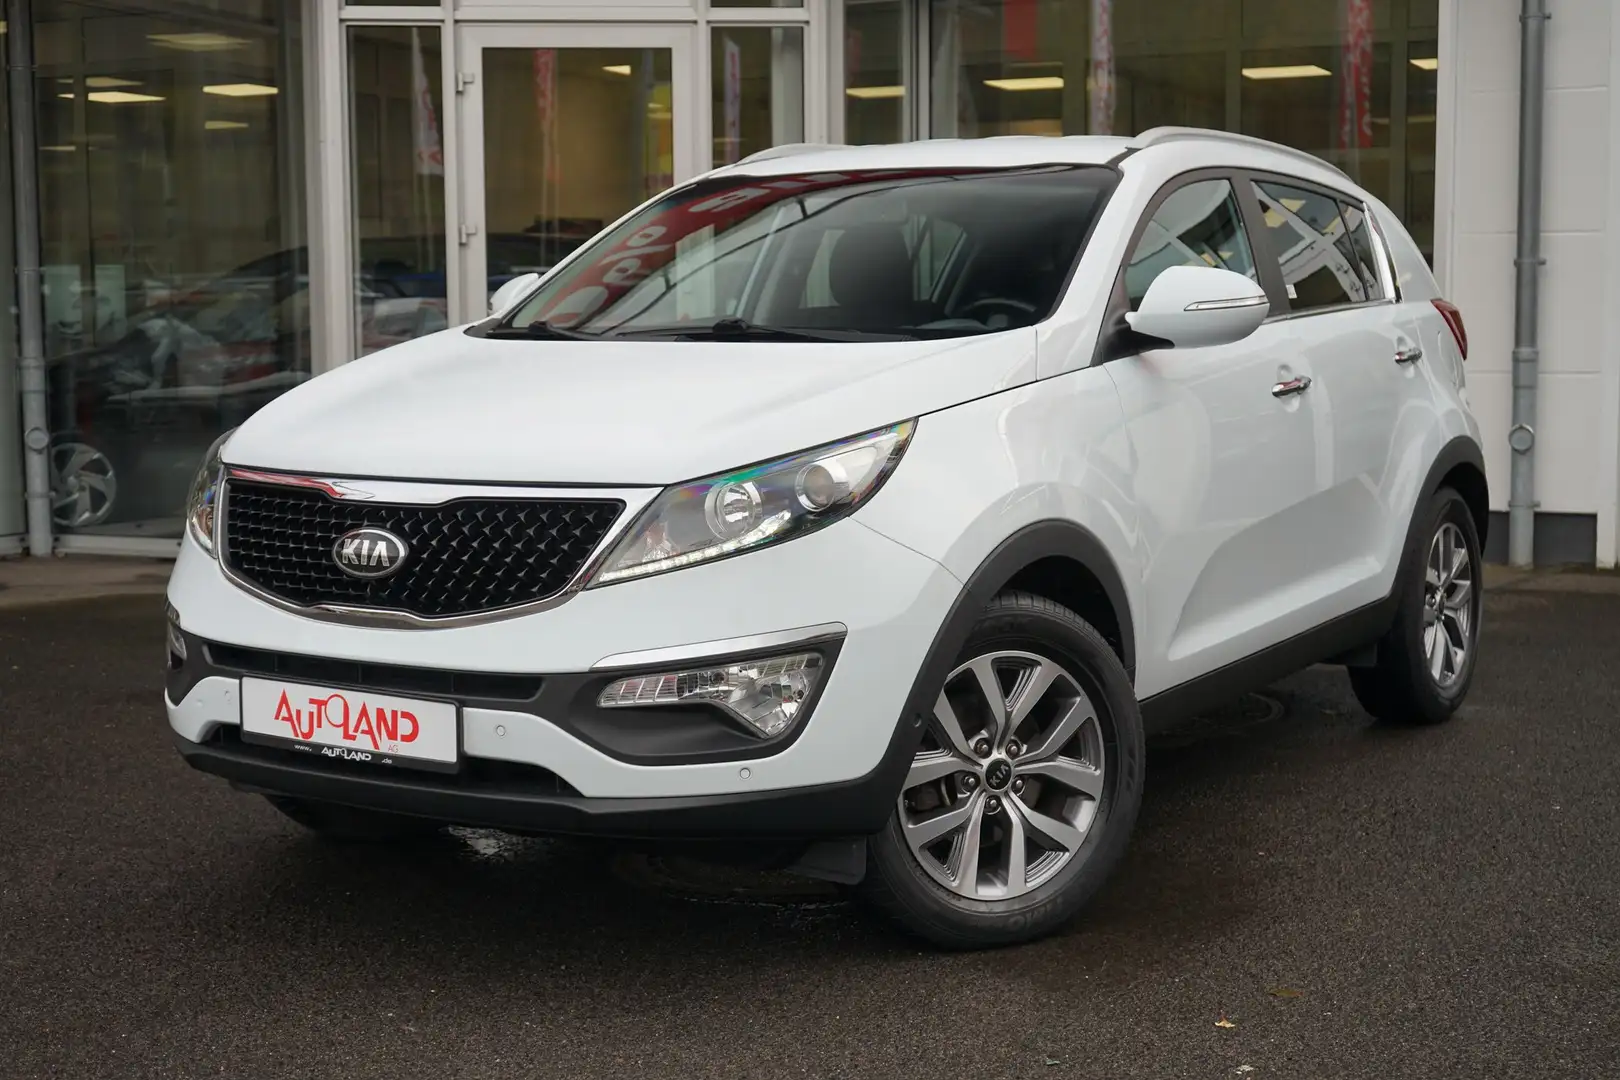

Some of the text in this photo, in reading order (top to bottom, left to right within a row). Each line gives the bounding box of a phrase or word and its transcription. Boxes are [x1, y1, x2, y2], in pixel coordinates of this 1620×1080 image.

[341, 538, 390, 567] KIA
[387, 744, 400, 754] AG
[989, 763, 1009, 787] KIA
